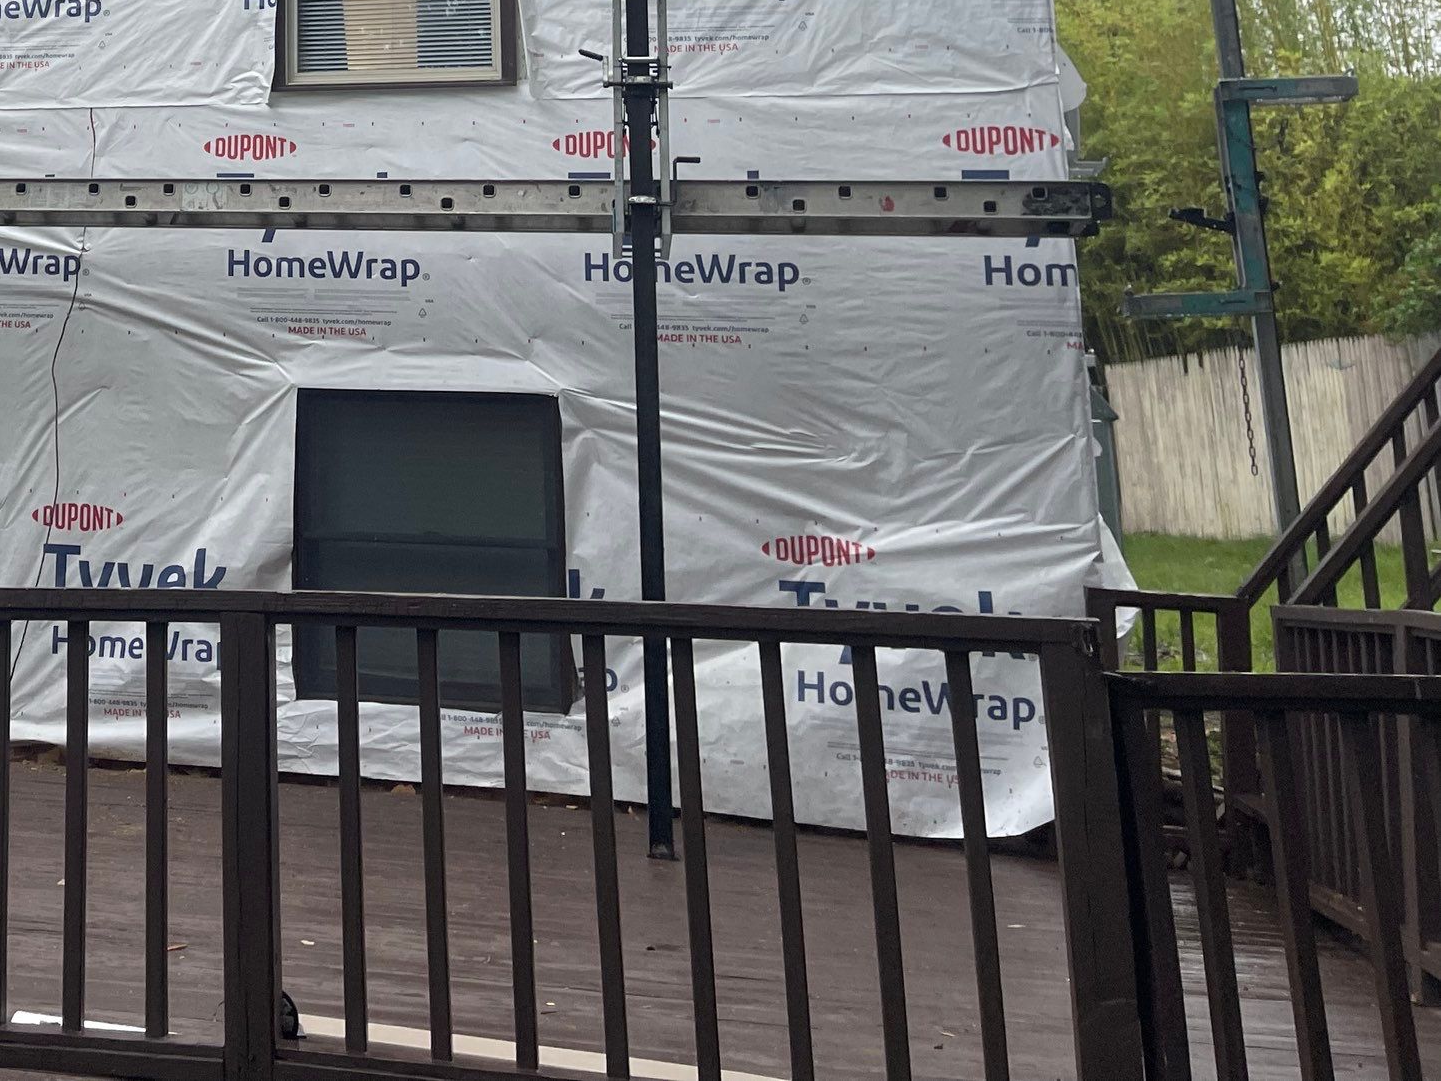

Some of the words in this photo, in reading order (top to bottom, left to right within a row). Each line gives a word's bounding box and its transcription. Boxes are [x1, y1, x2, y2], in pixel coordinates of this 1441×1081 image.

[684, 44, 696, 53] IN
[698, 44, 717, 52] THE
[719, 43, 739, 53] USA
[6, 61, 16, 69] IN
[17, 61, 32, 69] THE
[34, 60, 50, 68] USA
[956, 126, 1047, 156] DUPONT
[215, 134, 287, 161] DUPONT
[227, 249, 421, 287] HomeWrap
[14, 320, 32, 329] USA
[288, 326, 315, 335] MADE
[317, 326, 327, 335] IN
[329, 327, 347, 335] THE
[348, 327, 367, 336] USA
[686, 334, 698, 343] IN
[699, 334, 720, 343] THE
[721, 335, 743, 344] USA
[43, 503, 113, 531] DUPONT
[776, 535, 863, 567] DUPONT
[104, 708, 129, 716] MADE
[131, 709, 142, 717] IN
[464, 726, 494, 735] MADE
[531, 730, 551, 739] USA
[909, 771, 920, 781] IN
[921, 771, 943, 782] THE
